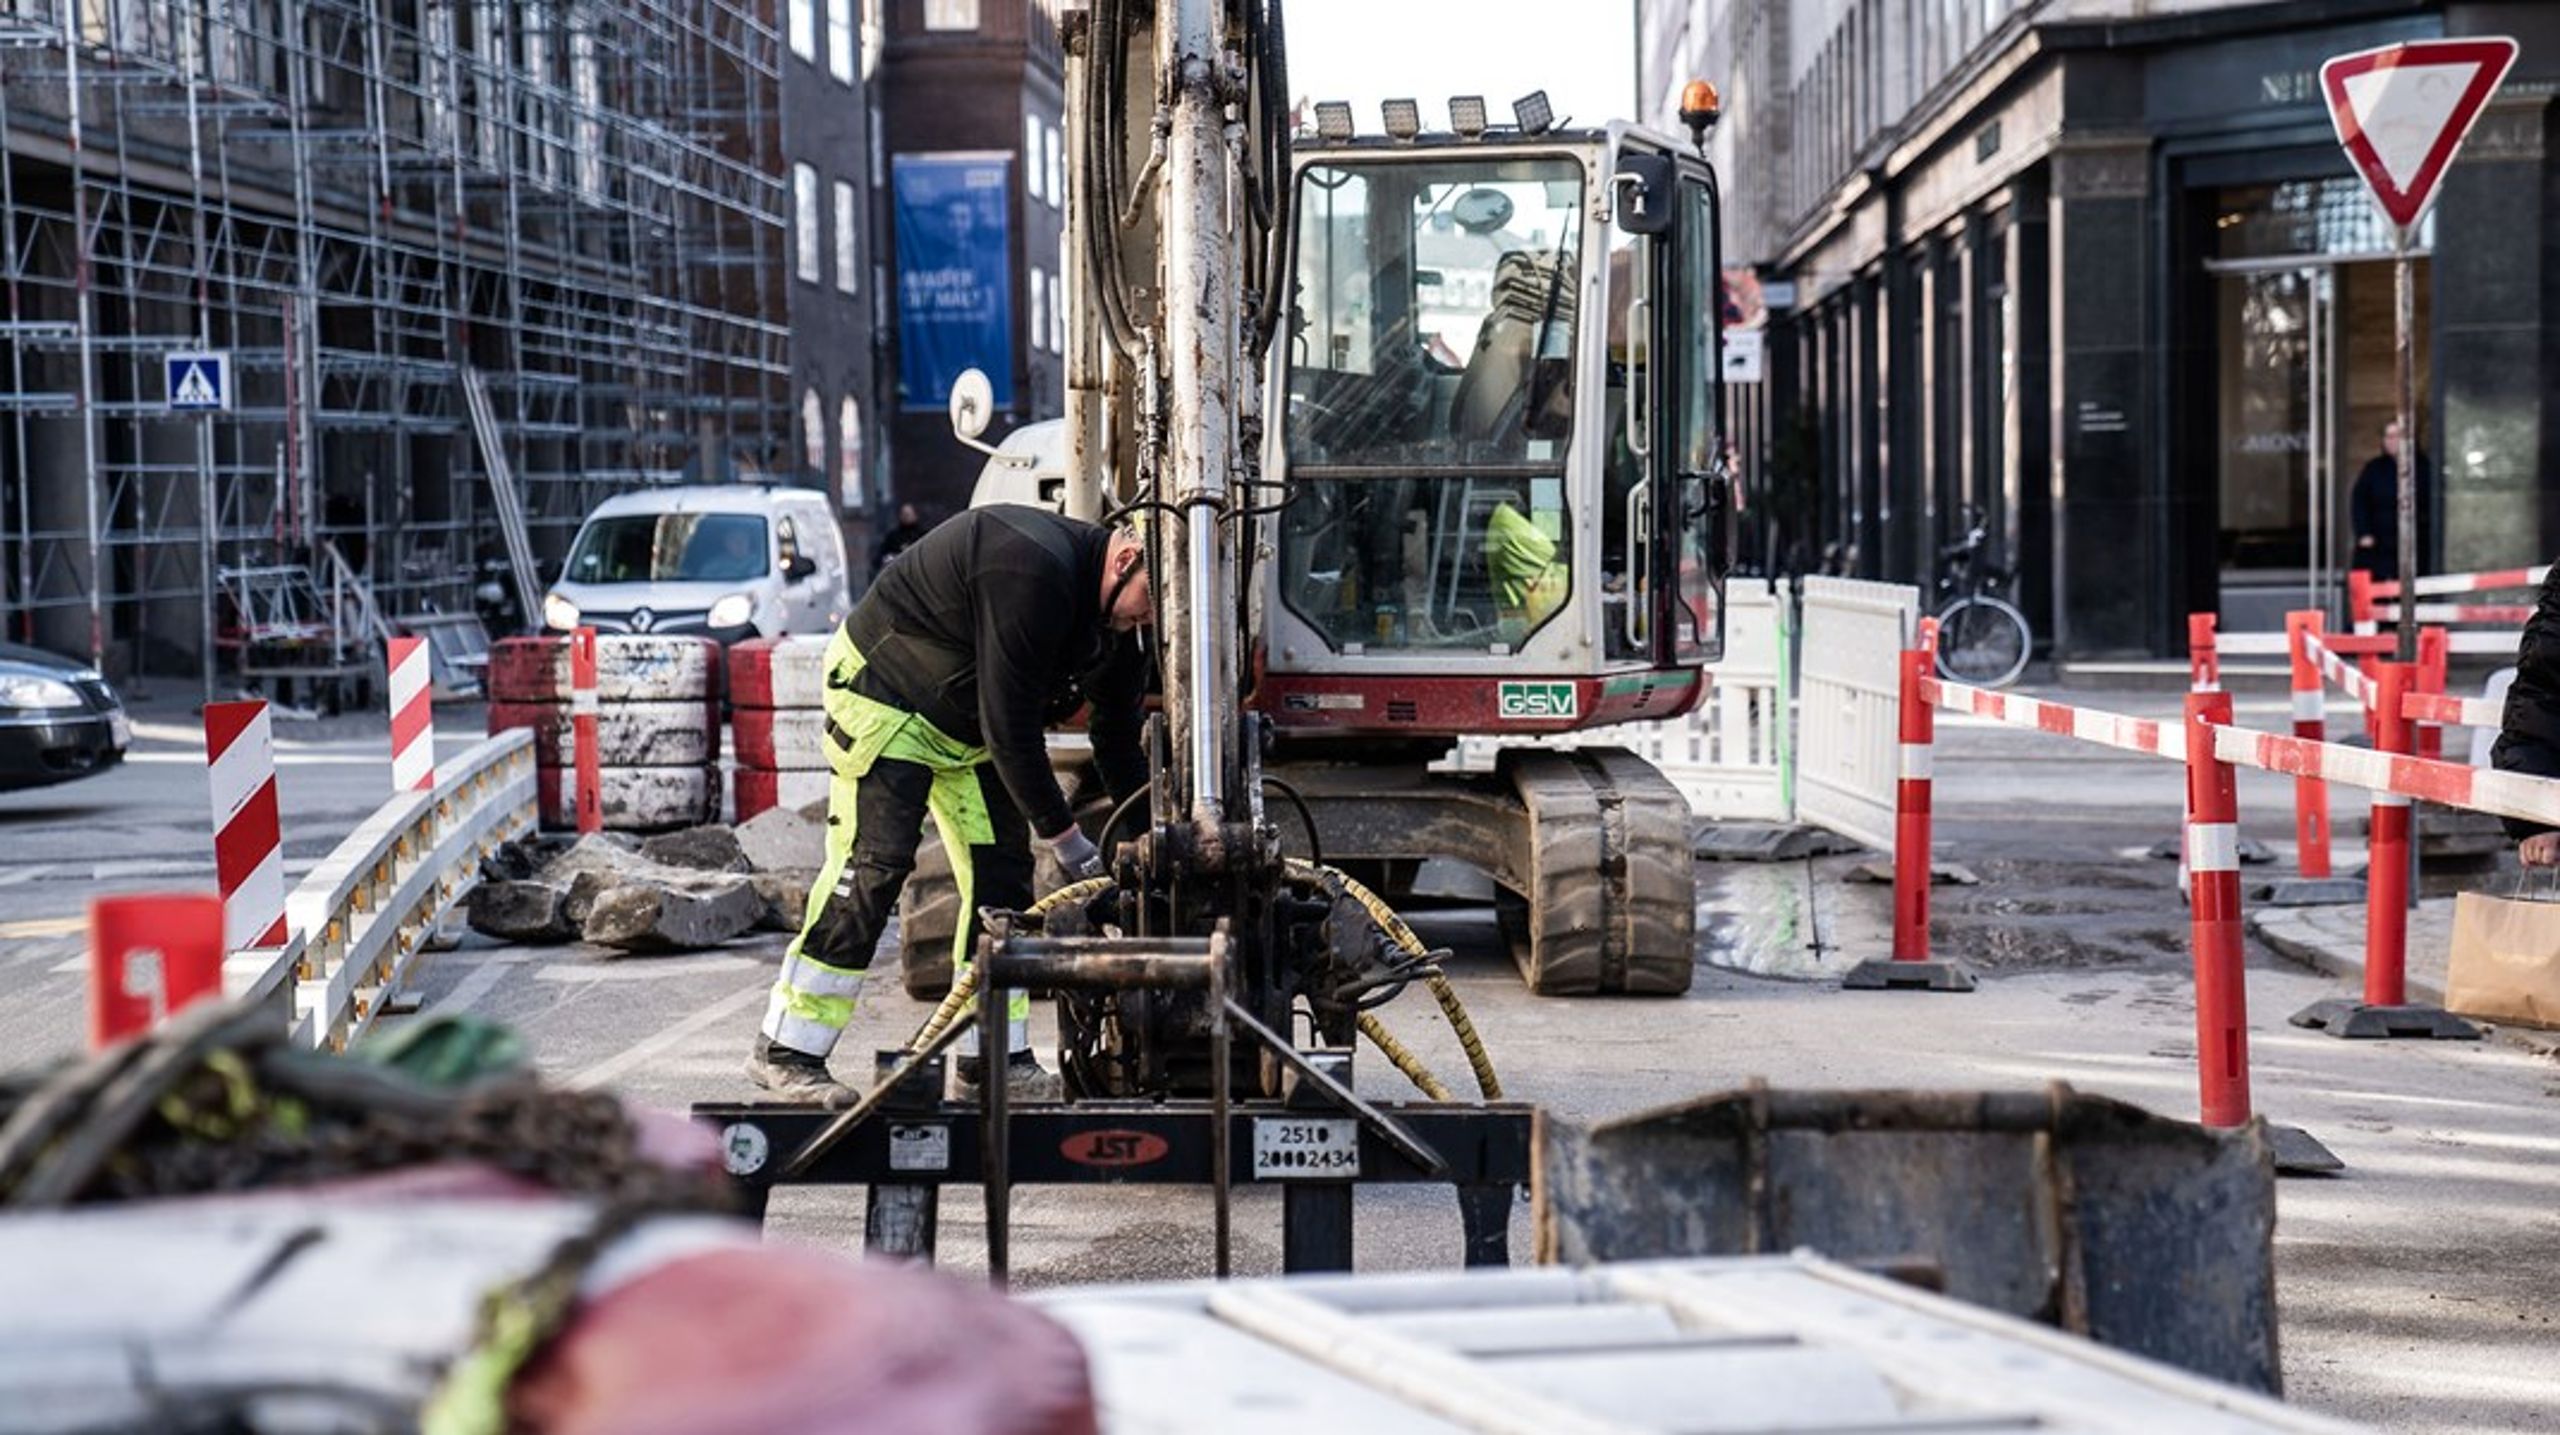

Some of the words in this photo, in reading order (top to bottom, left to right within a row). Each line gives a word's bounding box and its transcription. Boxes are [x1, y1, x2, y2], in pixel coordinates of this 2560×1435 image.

[1504, 693, 1571, 715] GSV
[1280, 1126, 1329, 1144] 2510
[1087, 1135, 1141, 1159] JST
[1258, 1150, 1356, 1168] 20002434
